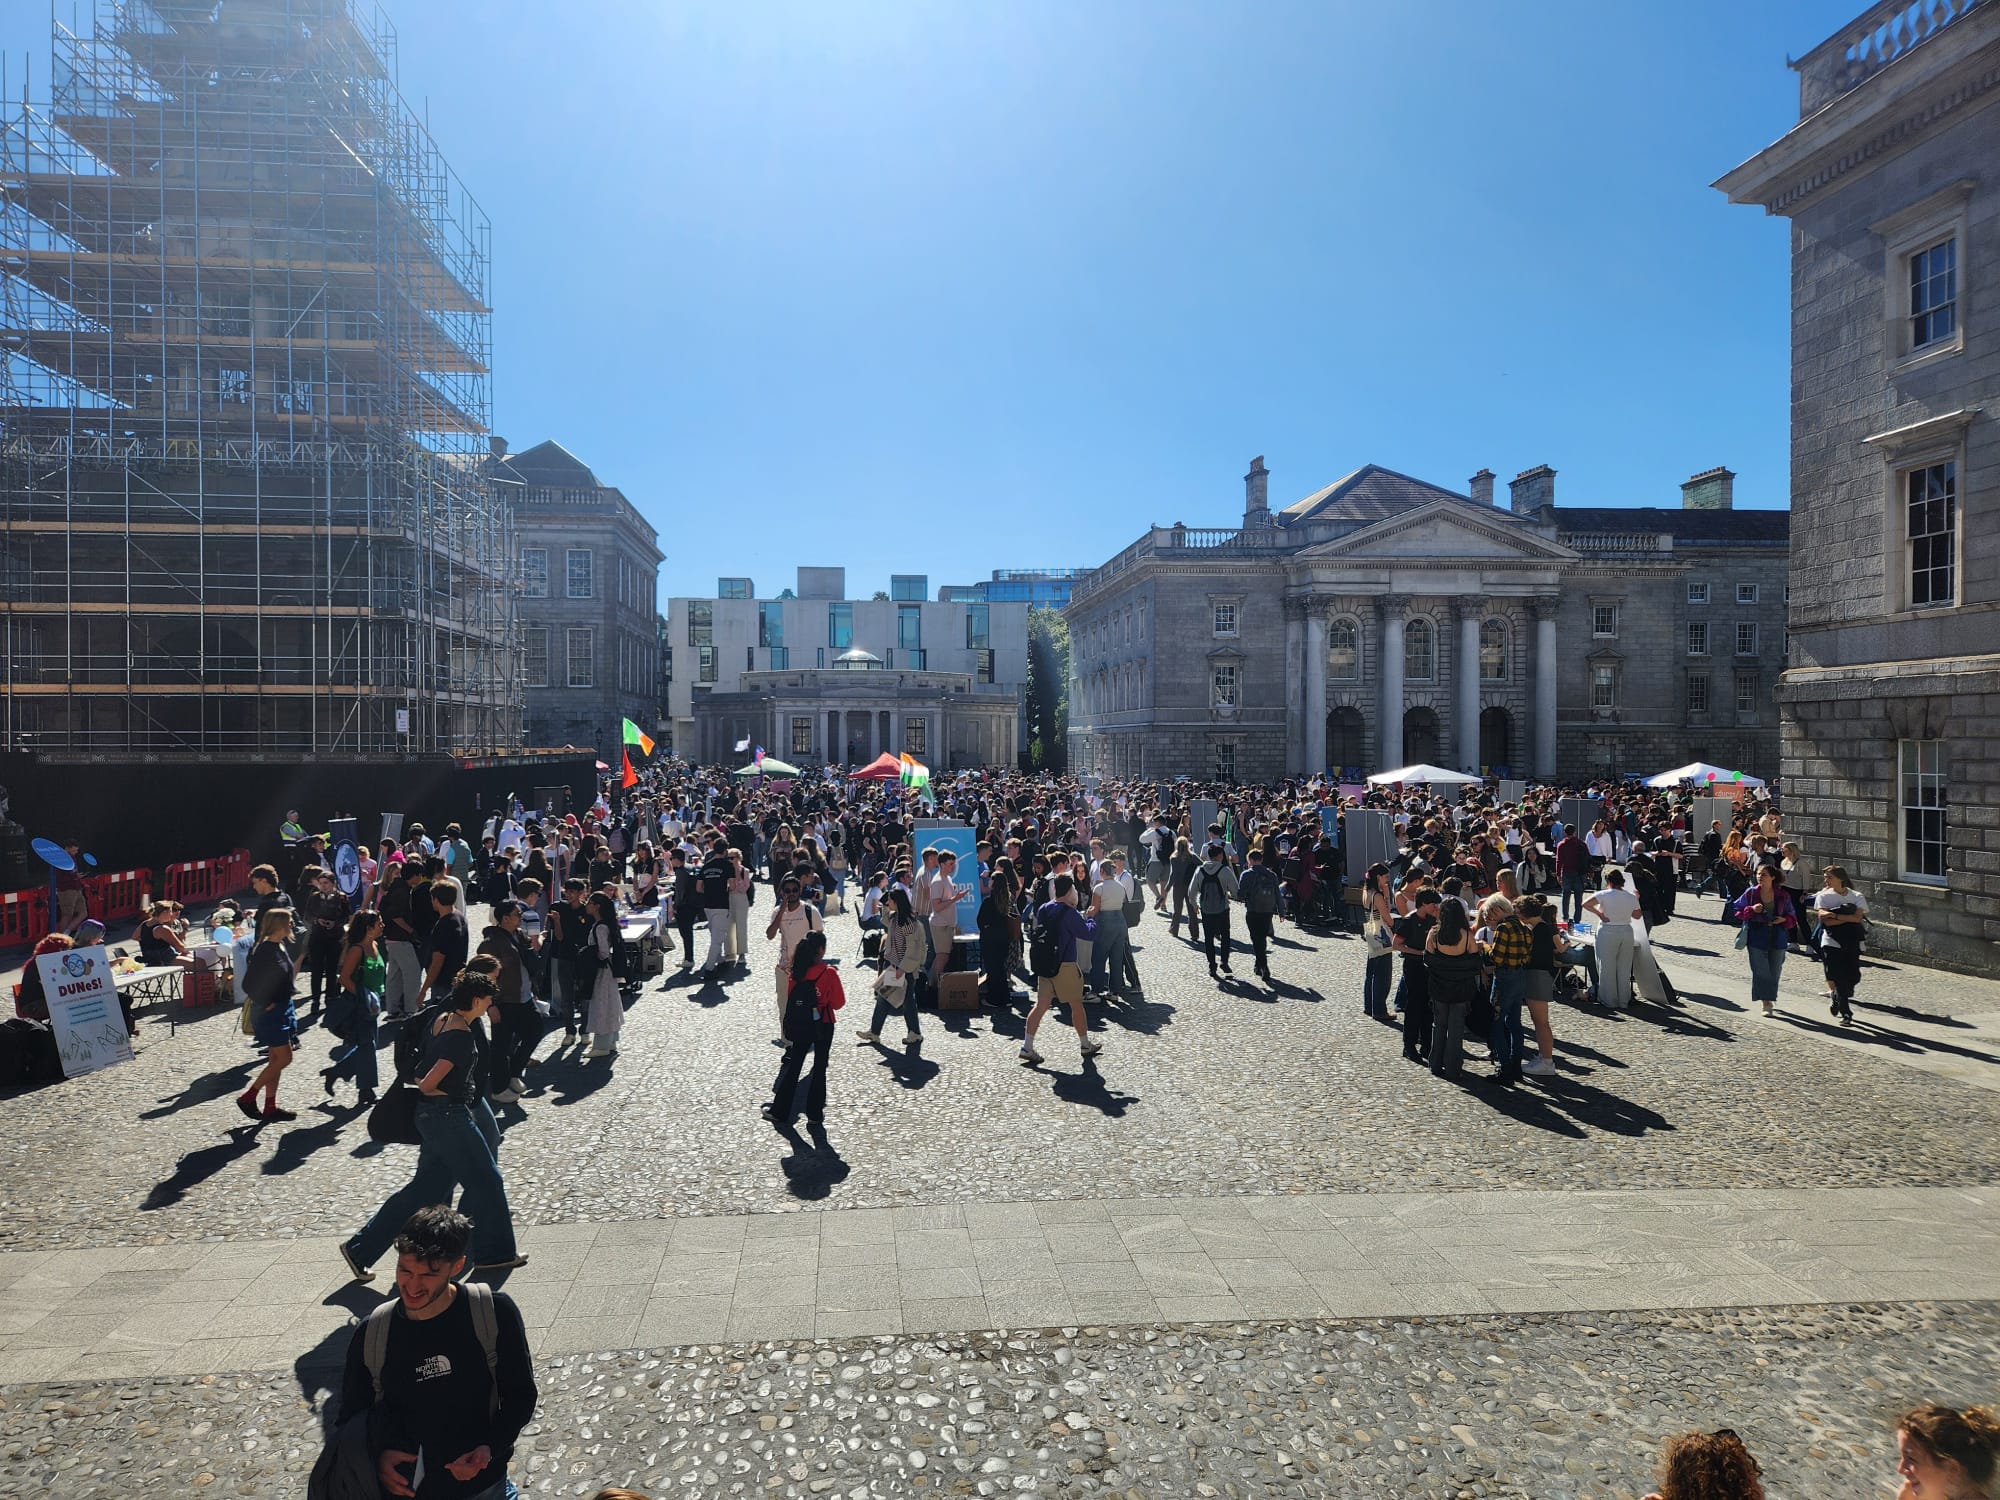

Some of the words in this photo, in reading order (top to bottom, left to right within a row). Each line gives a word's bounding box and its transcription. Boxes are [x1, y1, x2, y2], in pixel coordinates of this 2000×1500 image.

[58, 978, 103, 997] DUNeS!
[416, 1362, 439, 1373] NORTH
[423, 1368, 441, 1377] FACE
